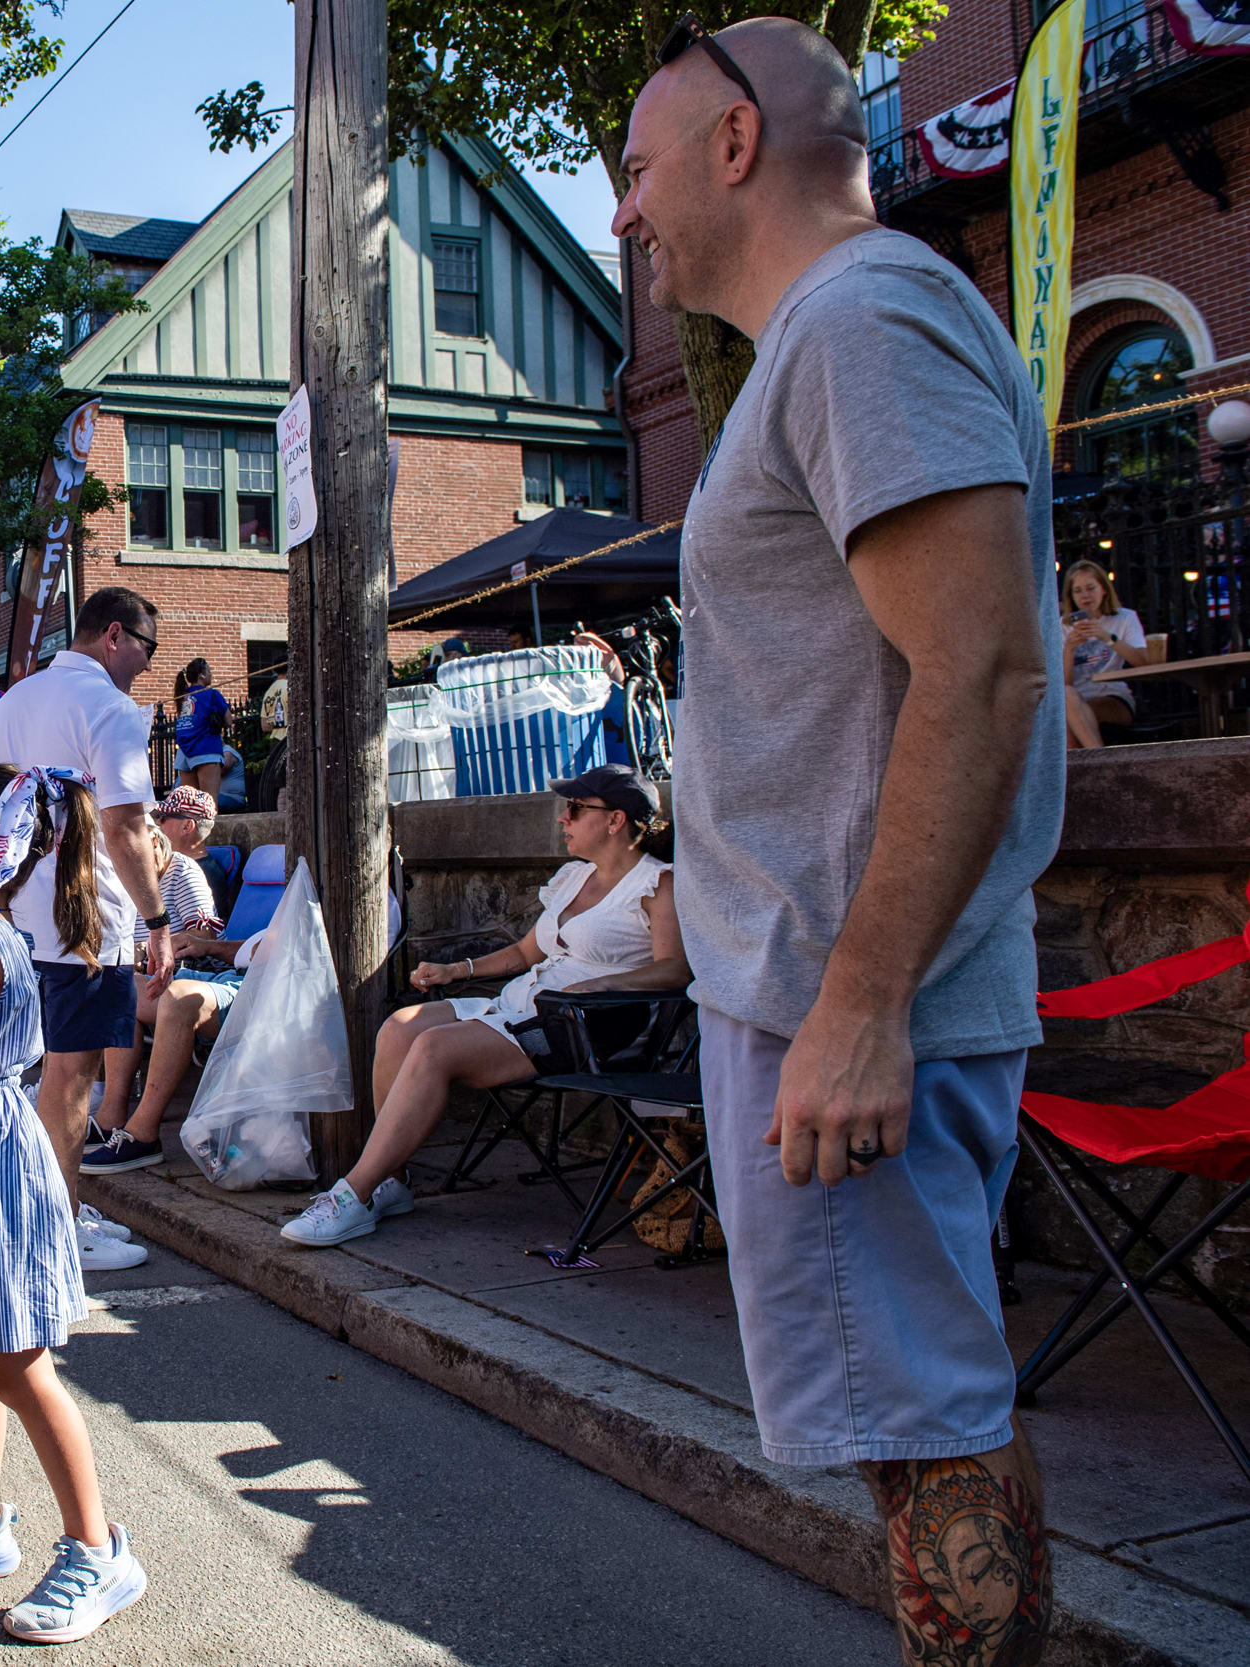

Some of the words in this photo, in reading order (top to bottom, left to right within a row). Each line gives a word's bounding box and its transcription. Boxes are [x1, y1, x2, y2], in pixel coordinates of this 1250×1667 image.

[1029, 76, 1063, 406] LEMONAD
[280, 421, 307, 456] ARKING
[286, 413, 297, 433] NO
[288, 438, 308, 465] ZONE
